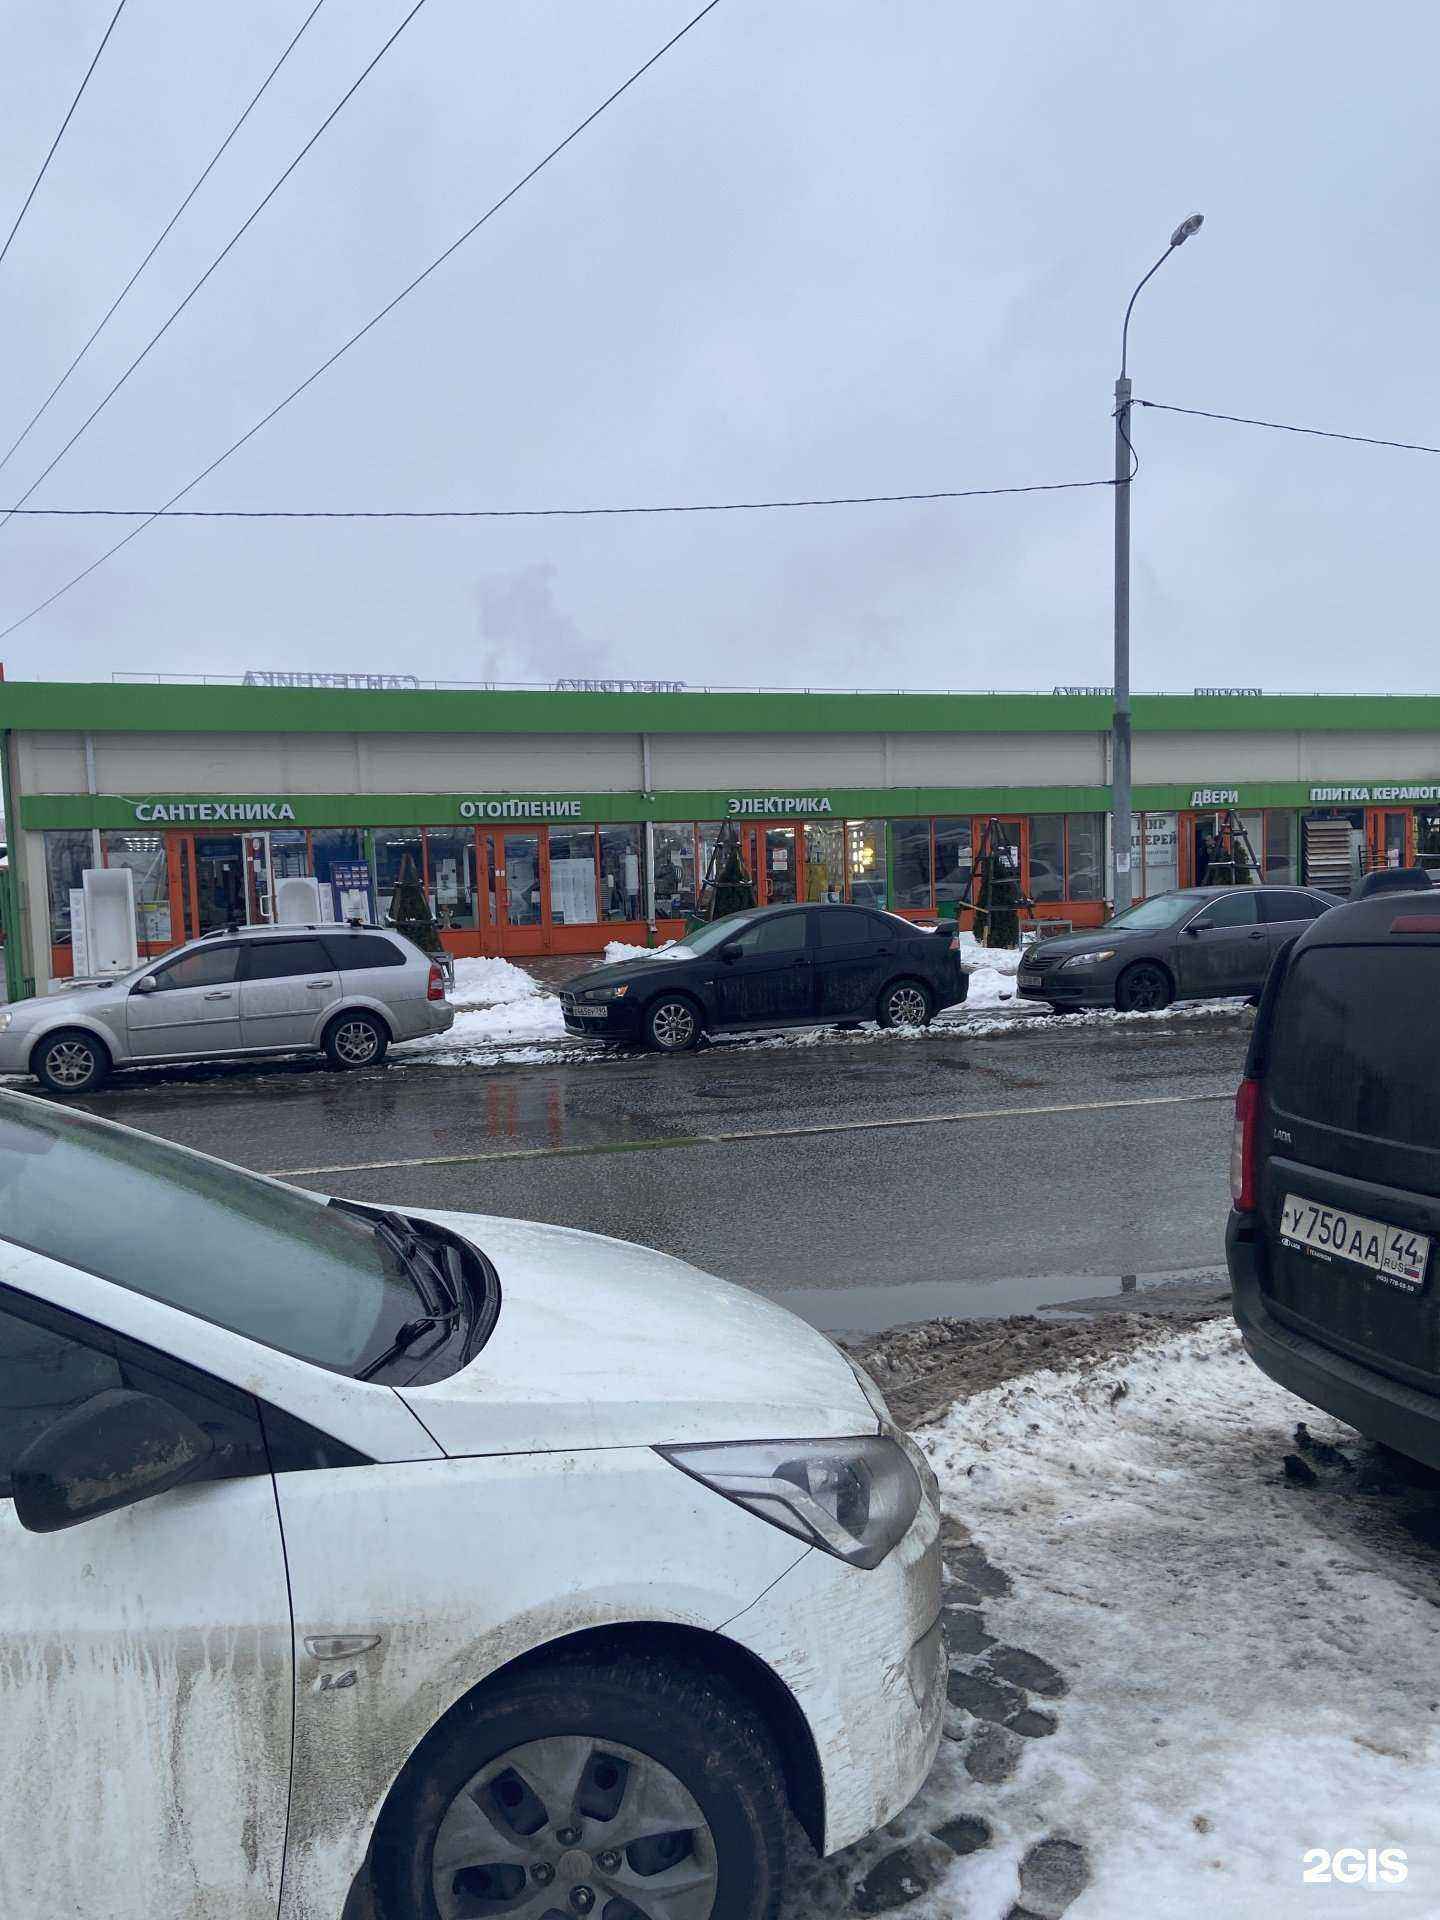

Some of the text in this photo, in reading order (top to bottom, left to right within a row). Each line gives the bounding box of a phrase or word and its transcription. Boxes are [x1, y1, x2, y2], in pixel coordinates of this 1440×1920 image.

[1190, 789, 1239, 806] ДВЕРИ
[1310, 787, 1369, 800] ПЛИТКА
[135, 803, 296, 821] САНТЕХНИКА
[460, 800, 582, 818] ОТОПЛЕНИЕ
[728, 797, 832, 814] ЭЛЕКТРИКА
[1383, 1256, 1405, 1273] RUS
